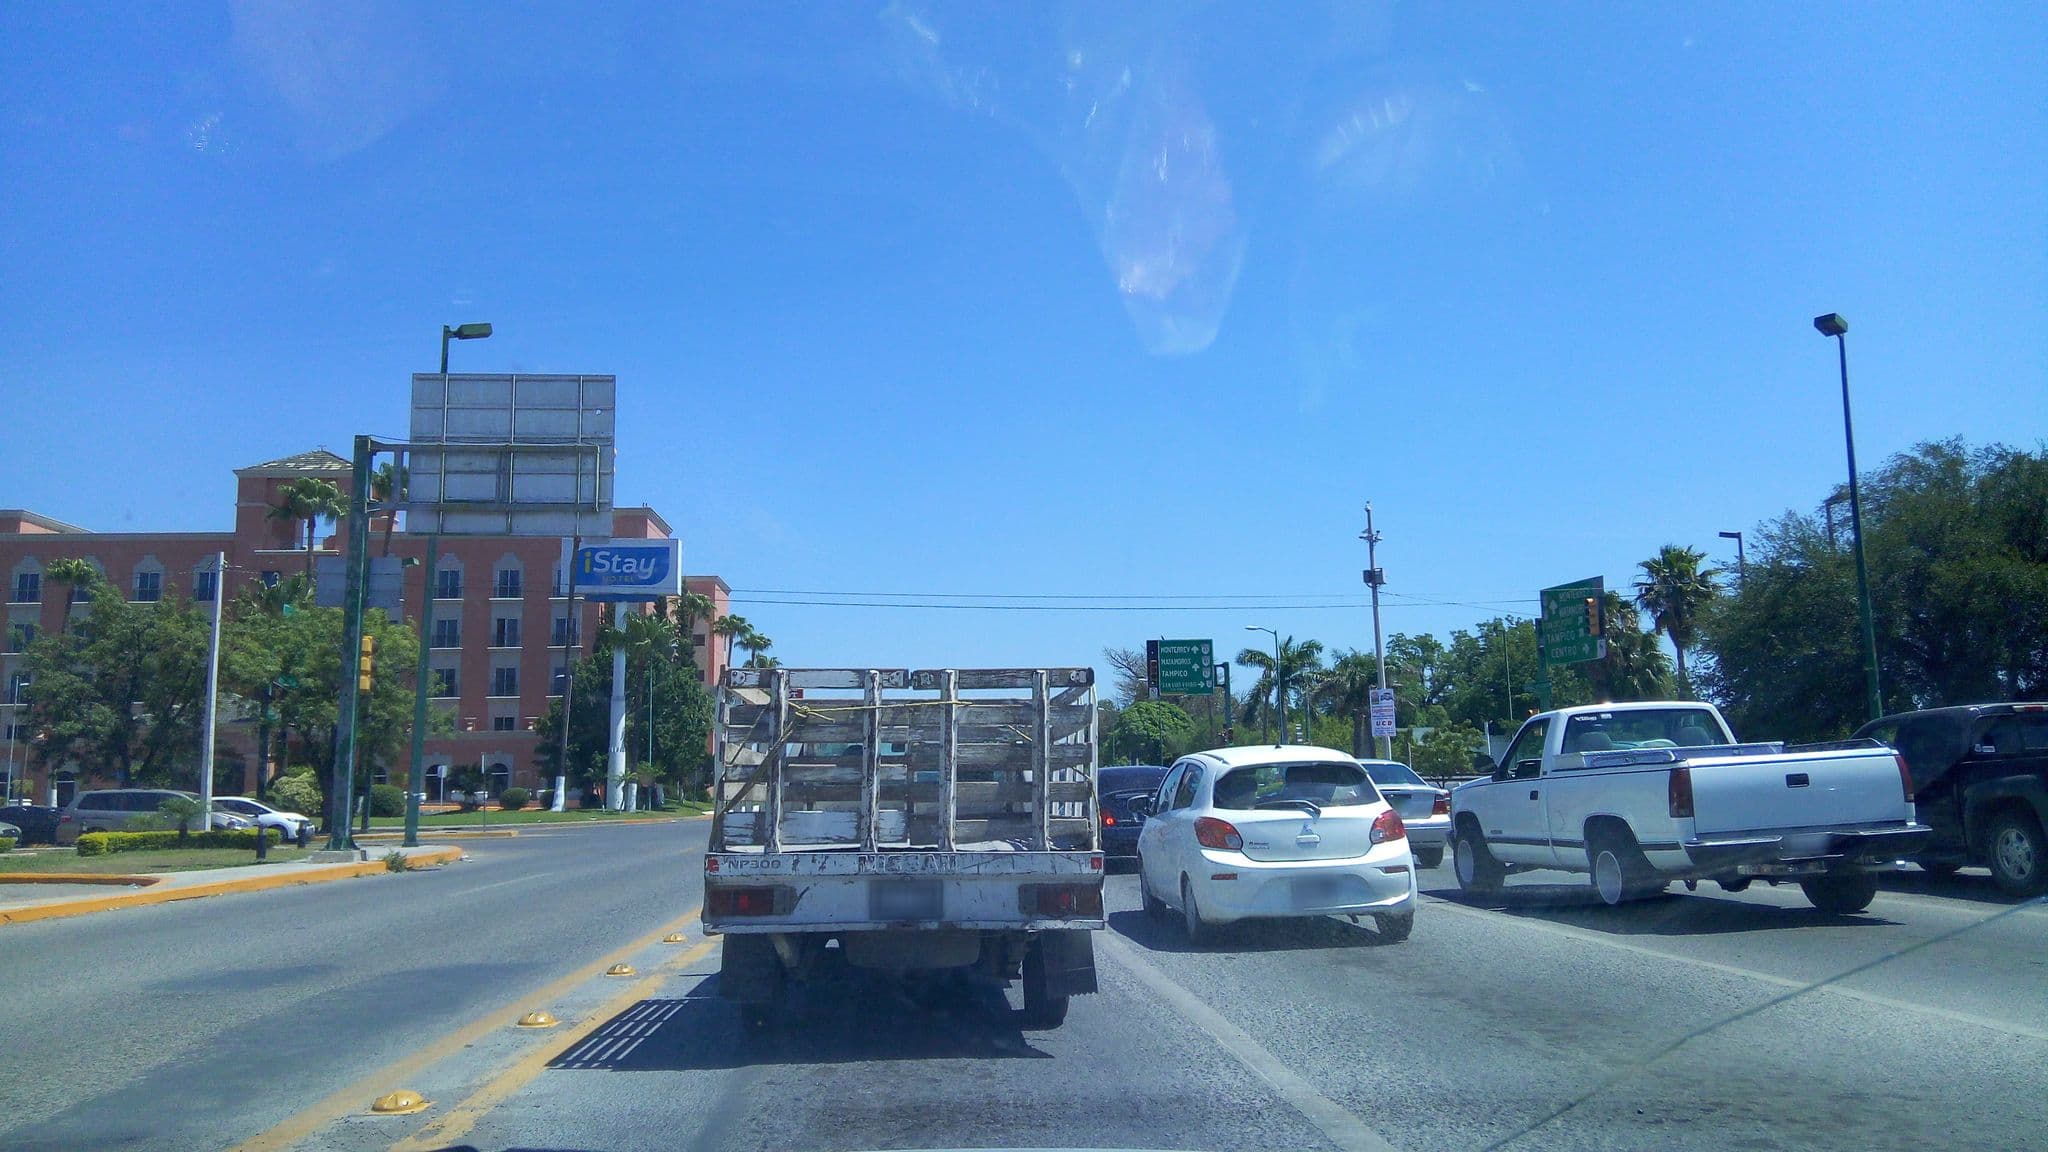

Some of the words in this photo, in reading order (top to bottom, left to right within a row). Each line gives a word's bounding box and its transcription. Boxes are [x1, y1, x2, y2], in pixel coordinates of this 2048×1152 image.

[584, 550, 656, 580] iStay
[1160, 646, 1191, 654] MONTERREY
[1551, 645, 1577, 658] CENTRO
[1161, 670, 1188, 678] TAMPICO
[728, 859, 781, 870] NP300
[858, 854, 958, 874] NISSAN
